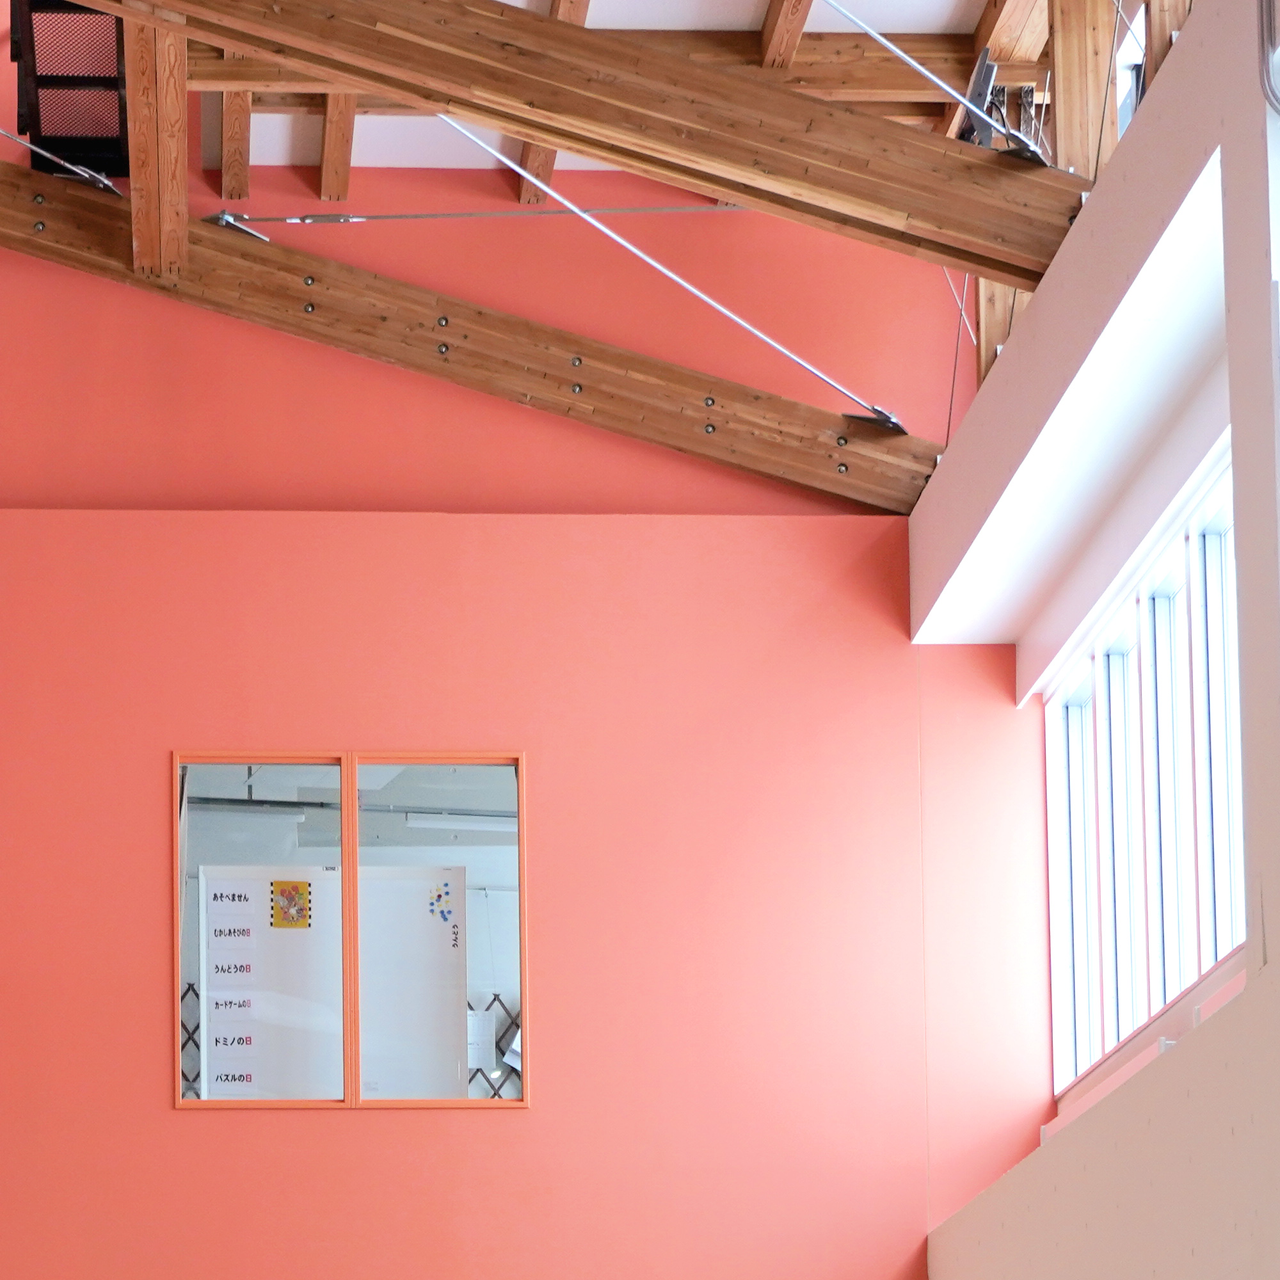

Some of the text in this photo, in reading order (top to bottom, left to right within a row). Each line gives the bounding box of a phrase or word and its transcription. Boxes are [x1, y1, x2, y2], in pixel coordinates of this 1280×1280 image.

[214, 963, 252, 974] うんどうの日
[214, 1036, 252, 1048] ドミノの日
